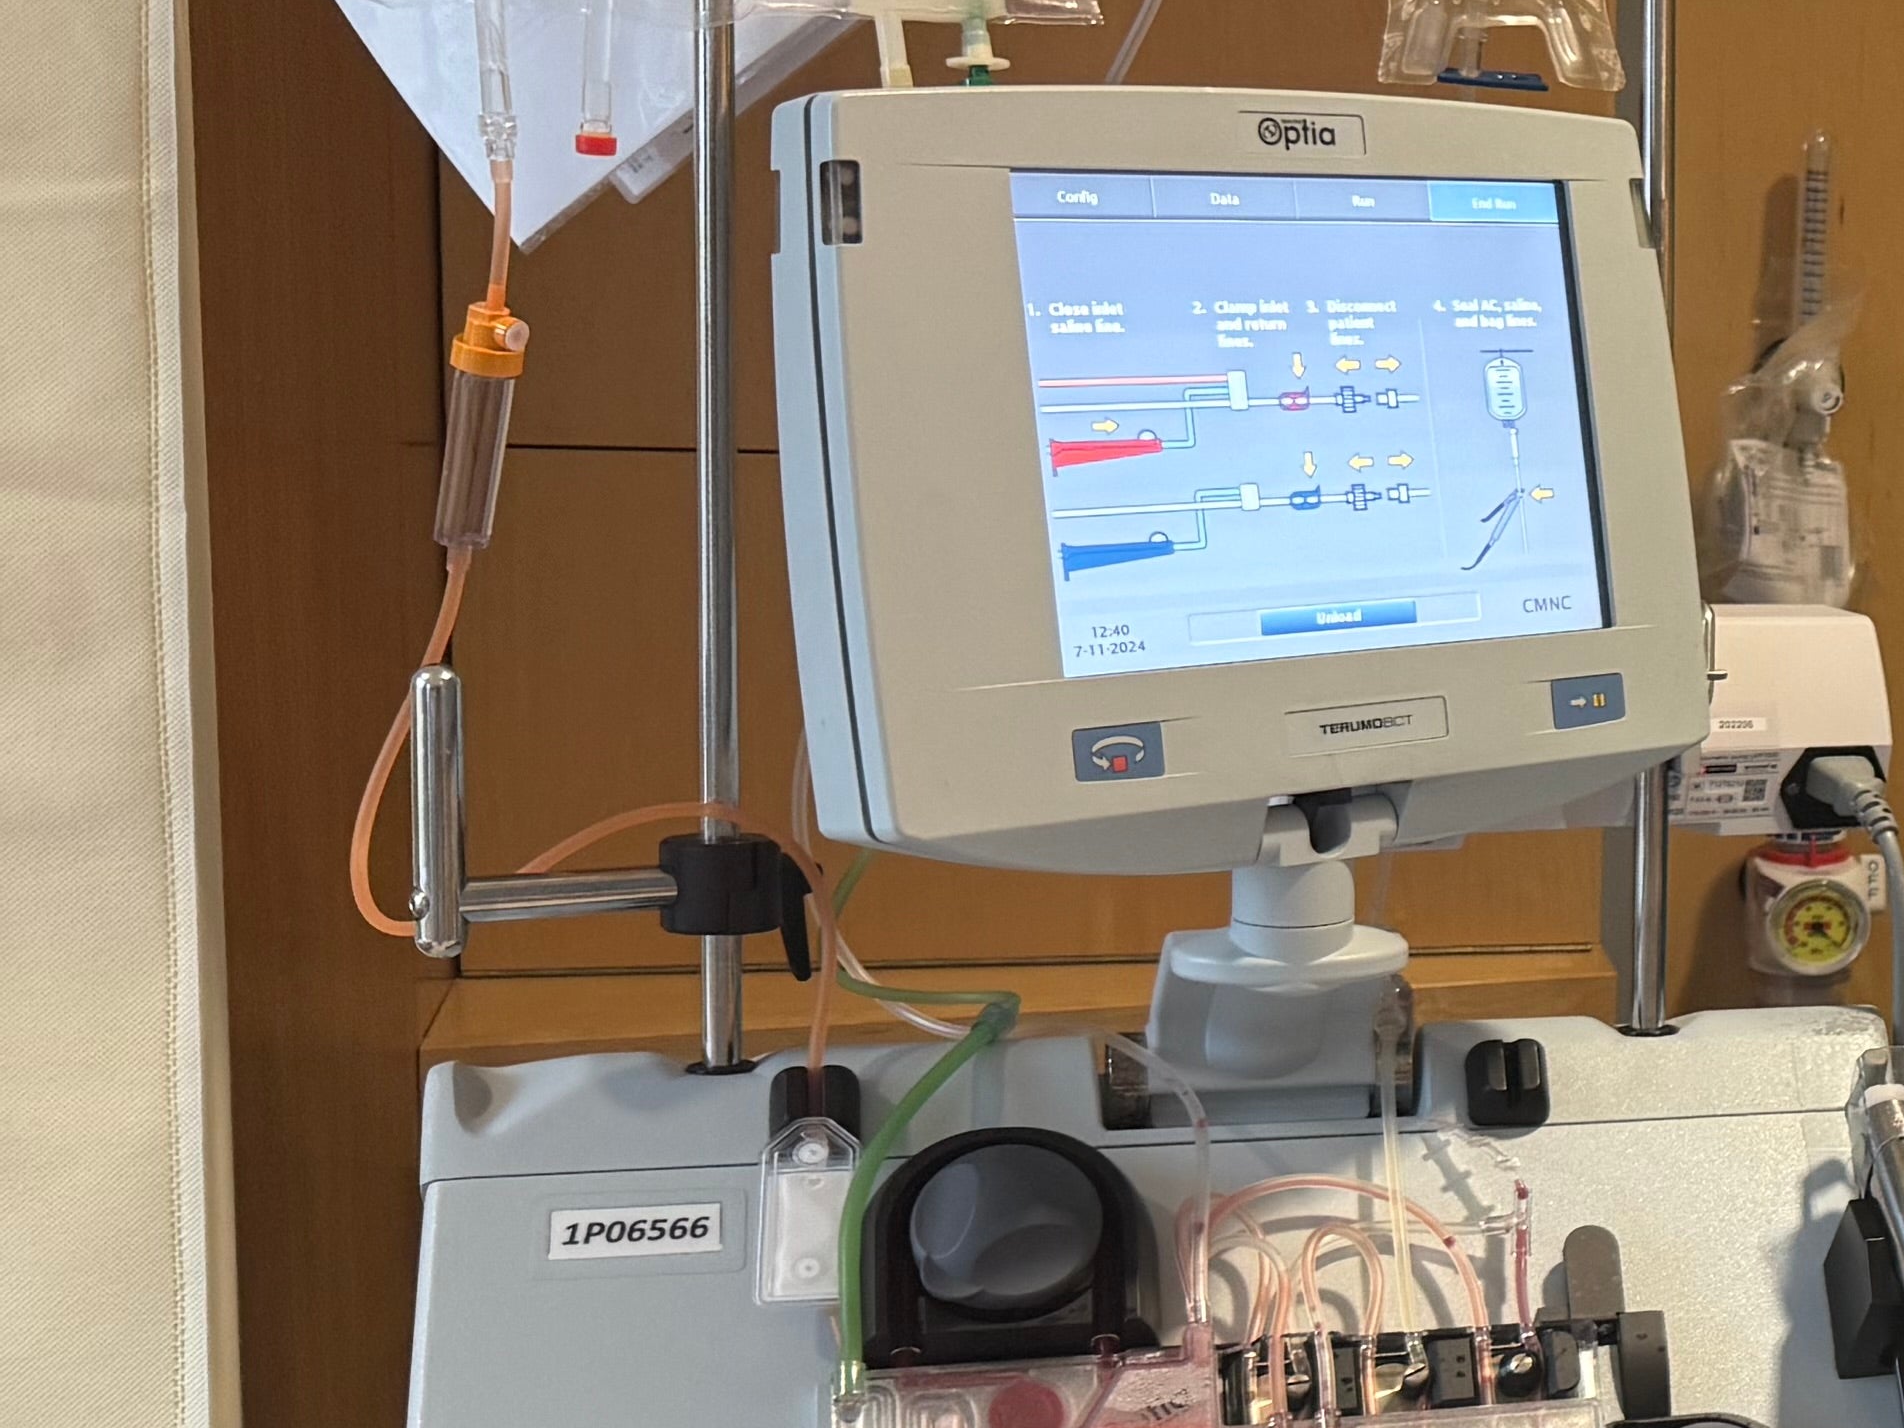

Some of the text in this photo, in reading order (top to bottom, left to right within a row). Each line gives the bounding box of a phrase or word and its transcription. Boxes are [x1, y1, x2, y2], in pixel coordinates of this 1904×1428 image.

[1258, 117, 1336, 151] Optia
[1057, 189, 1098, 207] Config
[1210, 192, 1239, 206] Data
[1352, 195, 1375, 208] Run
[1472, 197, 1516, 211] End Run
[1028, 300, 1124, 317] 1. Close inlet
[1192, 299, 1290, 317] 2. Clamp inlet
[1326, 299, 1397, 313] Disconnect
[1432, 299, 1446, 312] 4.
[1452, 299, 1478, 313] Seal
[1504, 298, 1542, 314] saline,
[1050, 318, 1126, 334] saline line.
[1216, 318, 1287, 332] and return
[1328, 315, 1375, 332] patient
[1455, 314, 1537, 330] and bag lines.
[1217, 334, 1255, 348] lines.
[1330, 331, 1365, 346] lines.
[1522, 595, 1573, 614] CMNC
[1316, 608, 1363, 626] Unload
[1090, 623, 1131, 639] 12:40
[1074, 639, 1146, 659] 7-11-2024
[1319, 713, 1414, 737] TERUMOBCT
[561, 1216, 710, 1247] 1P06566
